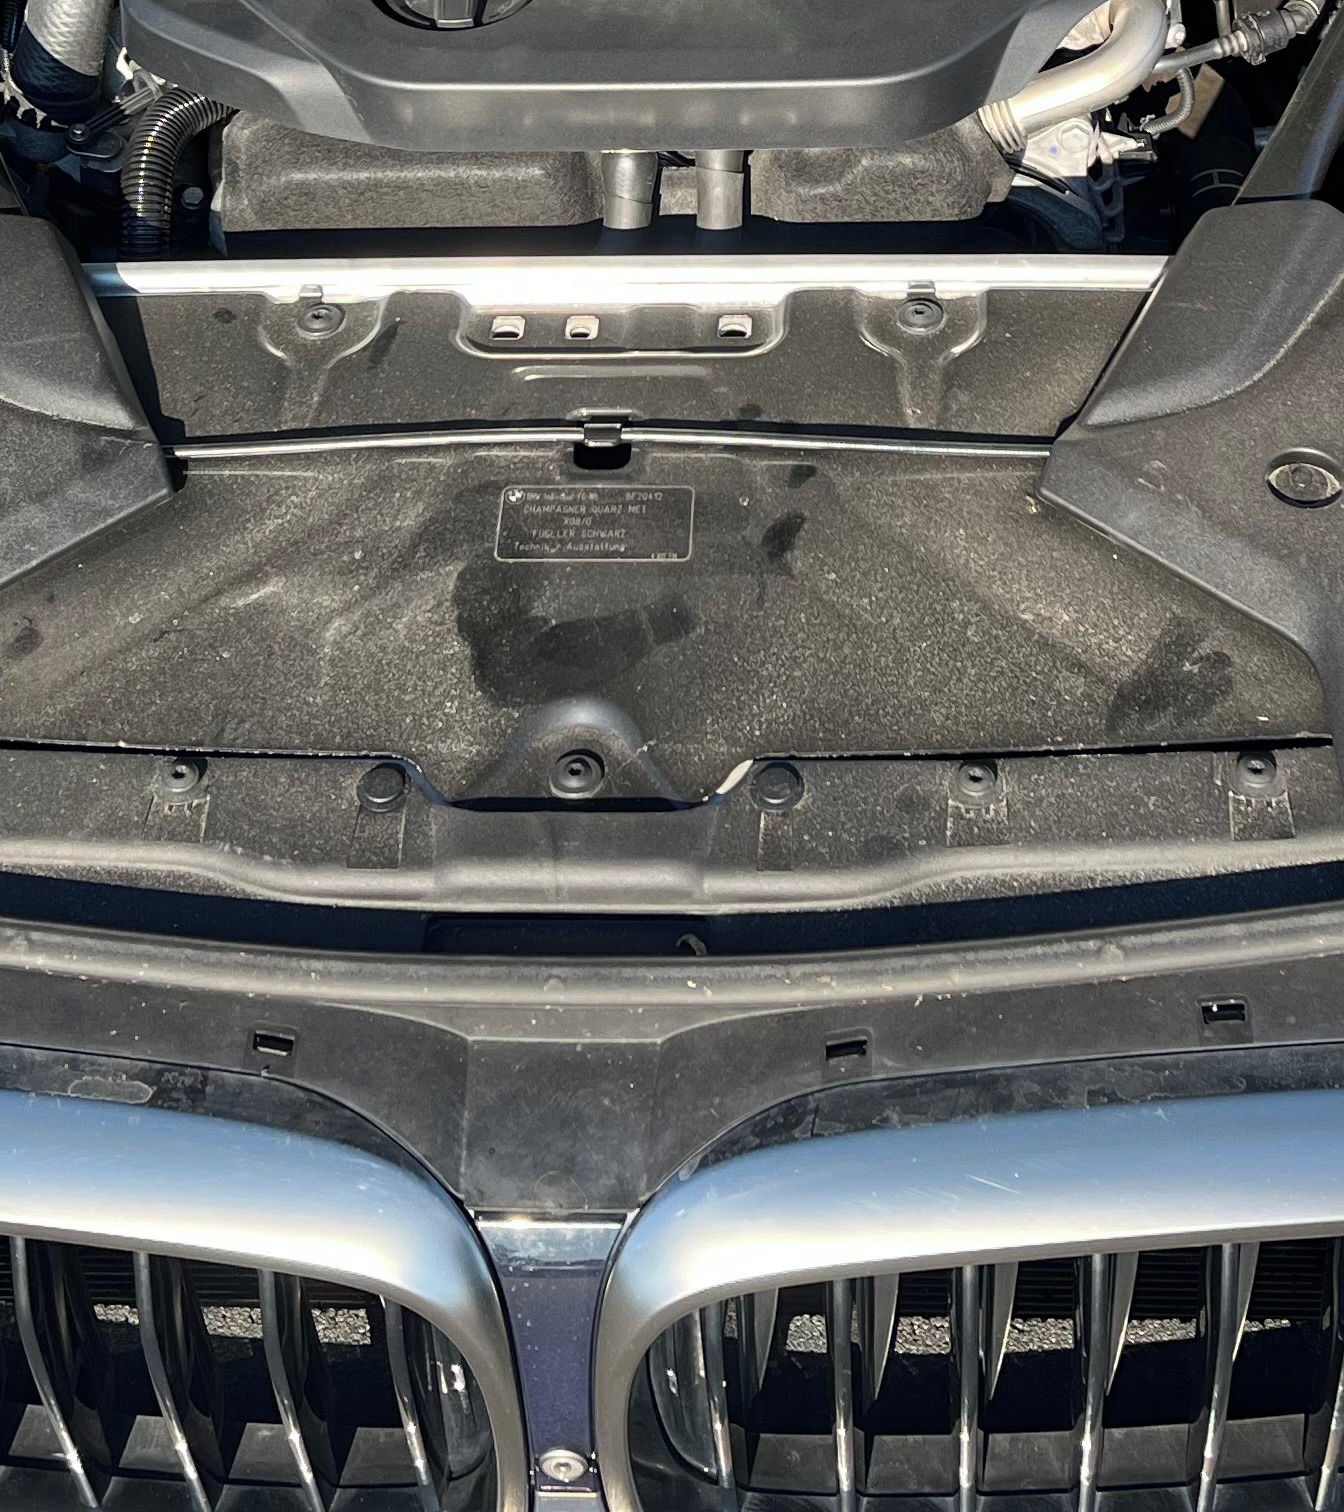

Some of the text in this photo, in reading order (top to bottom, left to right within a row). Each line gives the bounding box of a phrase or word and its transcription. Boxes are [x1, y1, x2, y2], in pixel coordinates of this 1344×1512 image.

[523, 504, 587, 514] CHAMPAGNER
[592, 504, 623, 514] QUARZ
[514, 541, 550, 552] Technik
[566, 541, 627, 553] Ausstattung
